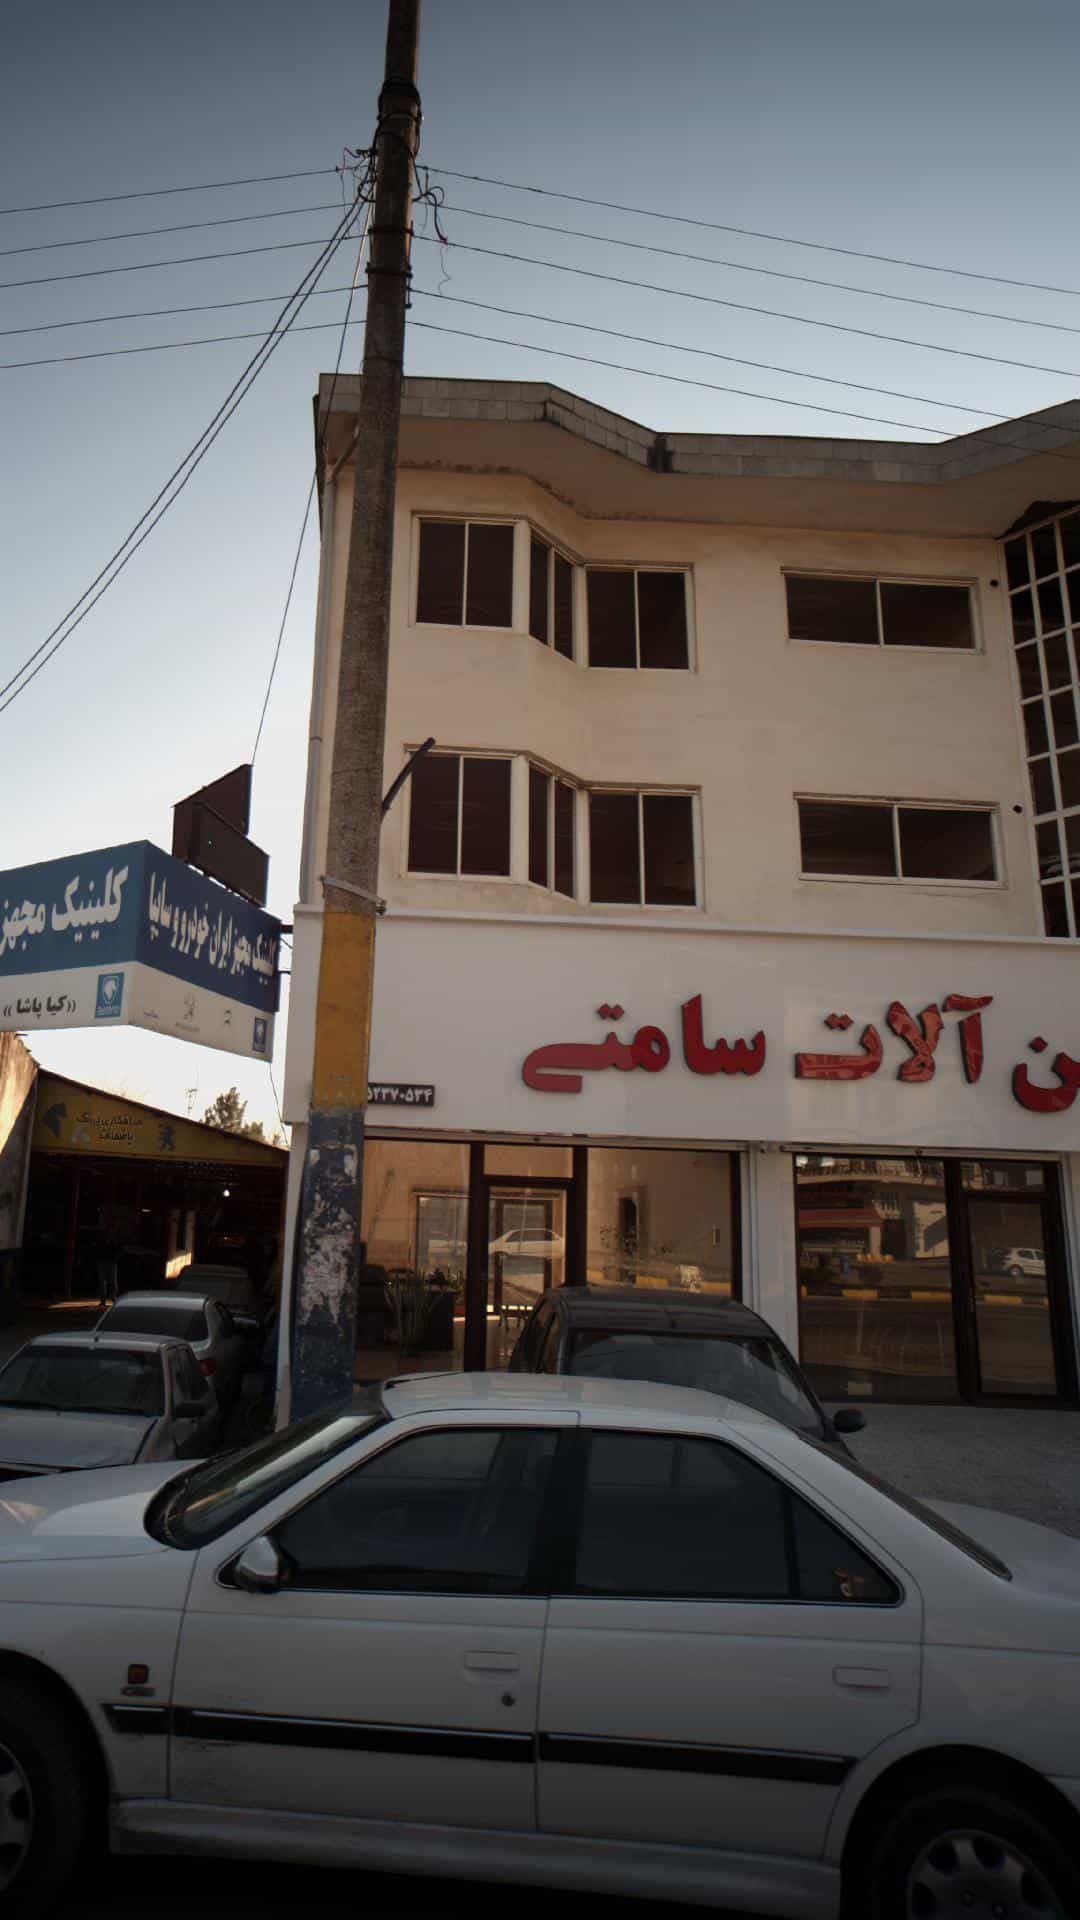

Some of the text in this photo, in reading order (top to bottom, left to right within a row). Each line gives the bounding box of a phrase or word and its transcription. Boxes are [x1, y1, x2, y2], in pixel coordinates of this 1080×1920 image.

[0, 865, 129, 955] کلینیک مجهز
[149, 871, 172, 942] سایپا
[209, 909, 233, 969] ایران
[795, 993, 994, 1084] آلات
